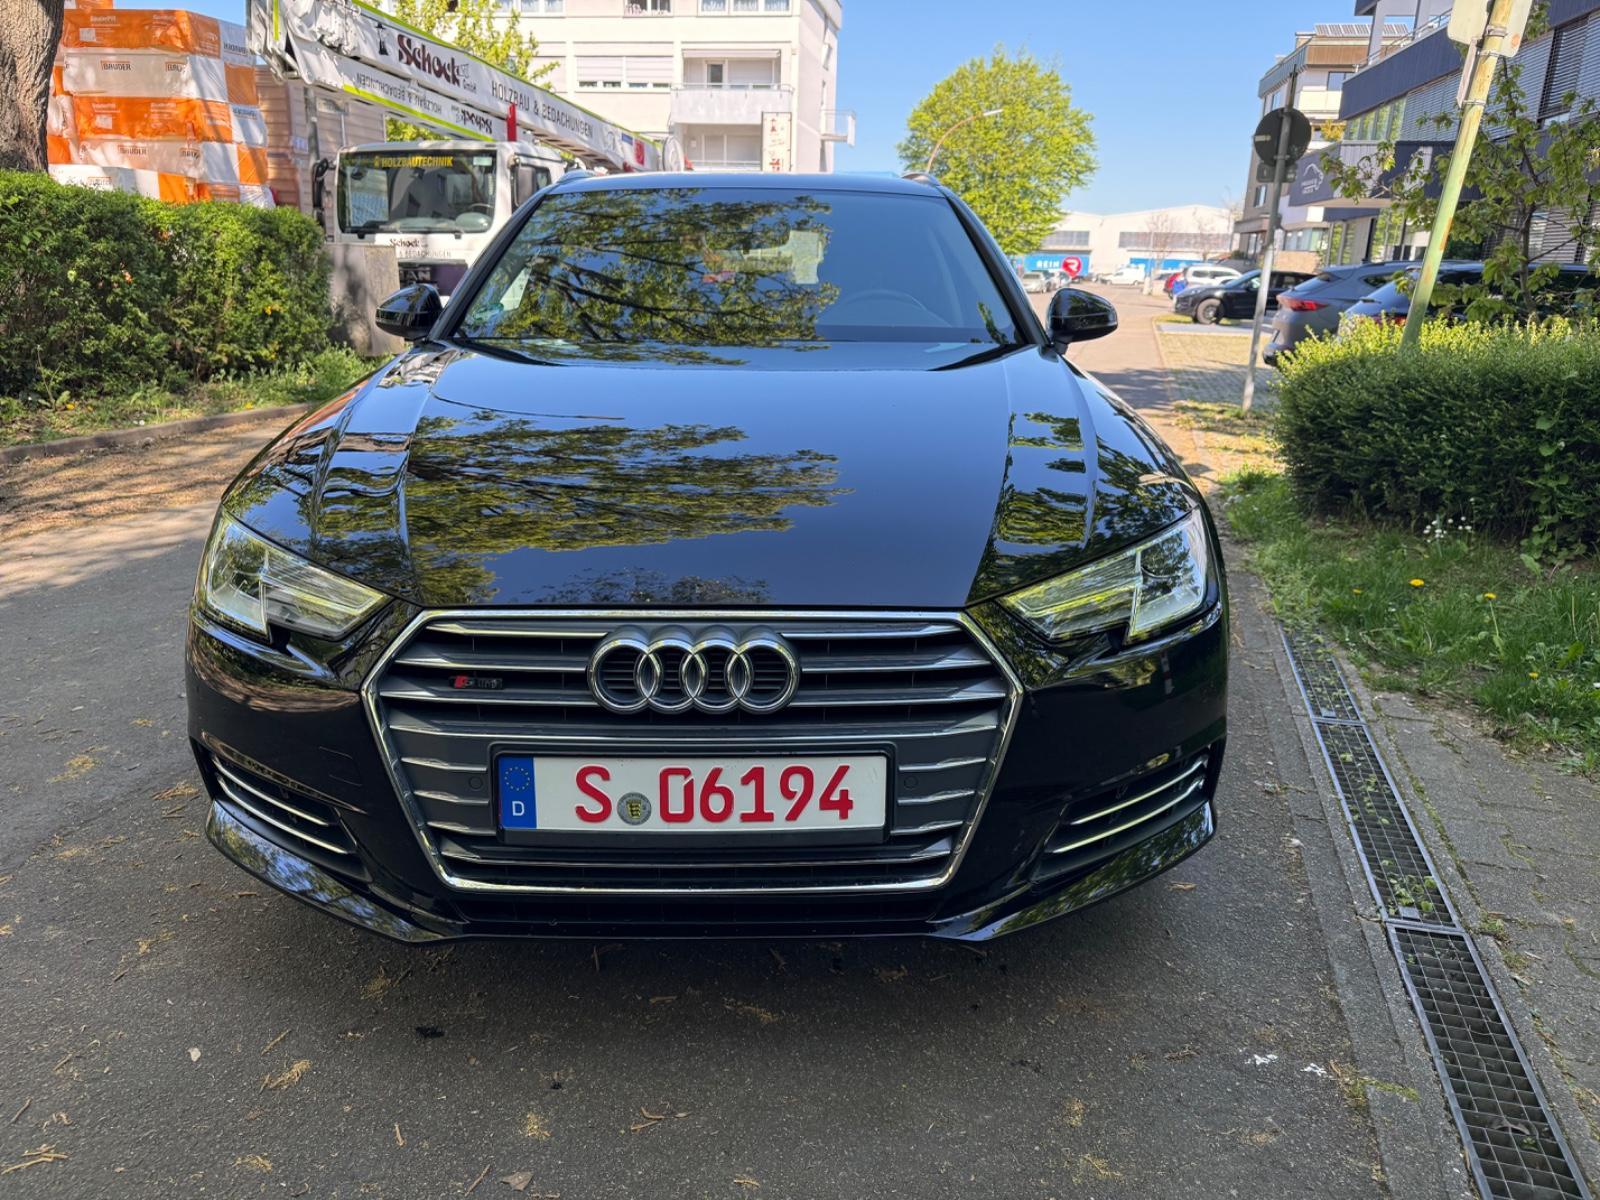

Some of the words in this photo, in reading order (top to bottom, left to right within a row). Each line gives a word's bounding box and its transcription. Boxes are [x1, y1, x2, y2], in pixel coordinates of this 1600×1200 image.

[397, 34, 460, 87] Schock
[491, 79, 530, 112] HOLZBAU
[542, 102, 593, 140] BEDACHUNGEN
[382, 156, 453, 168] HOLZBAUTECHNIK
[511, 800, 526, 817] D
[574, 764, 613, 824] S
[658, 764, 854, 824] 06194
